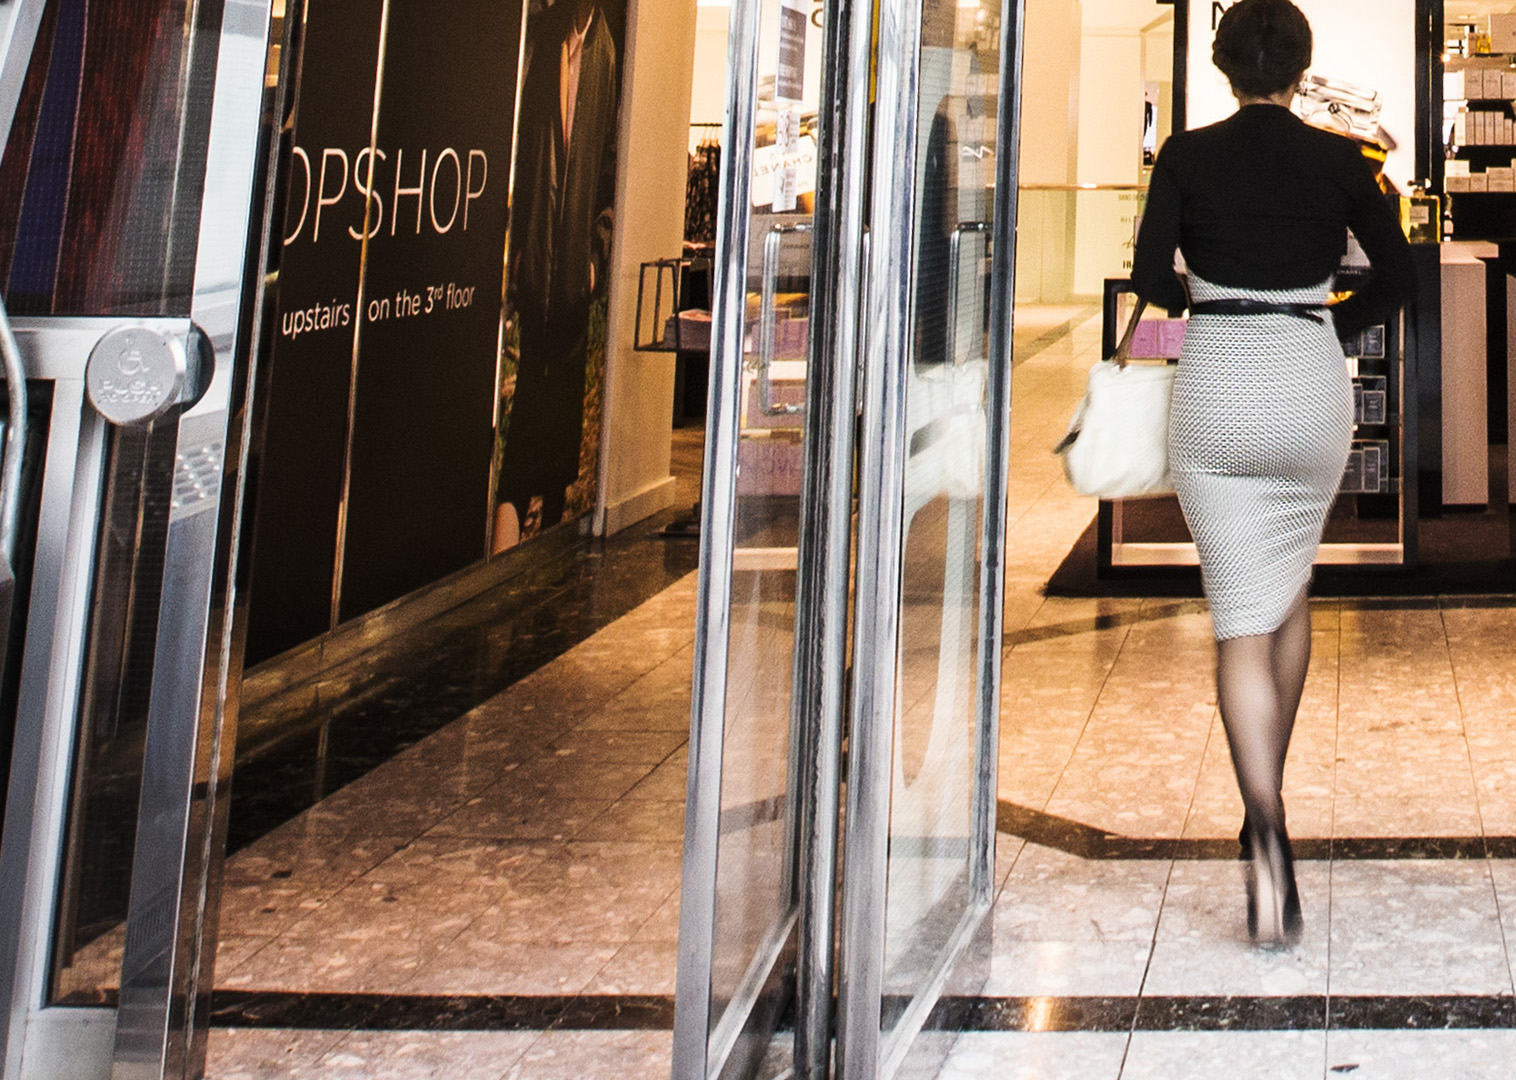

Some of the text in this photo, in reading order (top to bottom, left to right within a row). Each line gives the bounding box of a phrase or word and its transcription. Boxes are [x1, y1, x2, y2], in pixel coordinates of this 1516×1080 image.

[281, 299, 350, 340] upstairs
[367, 295, 391, 322] on
[395, 290, 421, 316] the
[445, 282, 476, 311] floor
